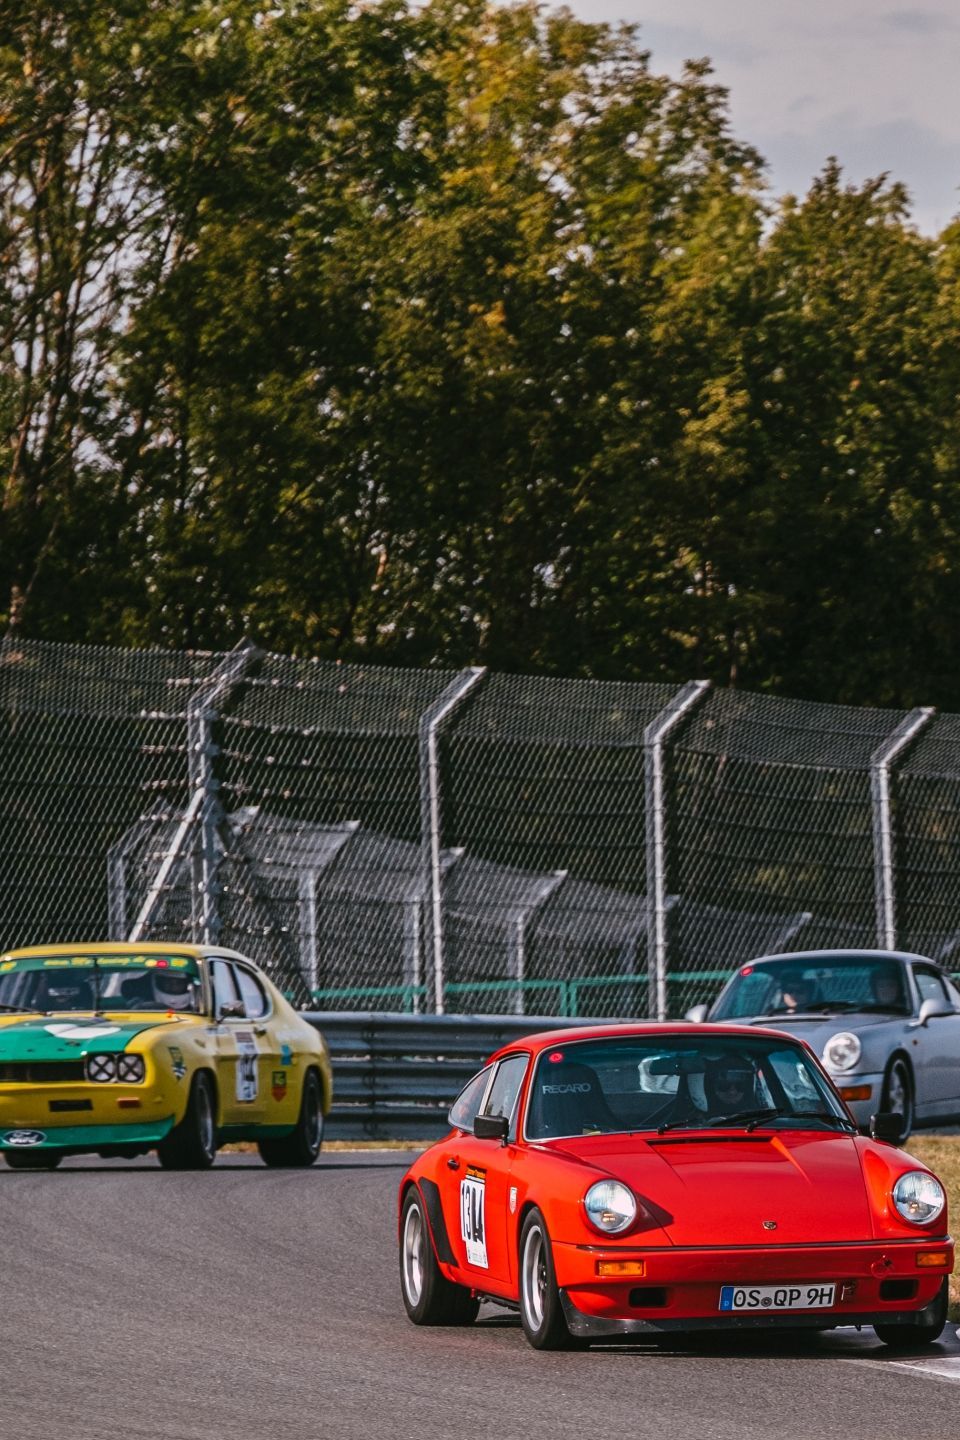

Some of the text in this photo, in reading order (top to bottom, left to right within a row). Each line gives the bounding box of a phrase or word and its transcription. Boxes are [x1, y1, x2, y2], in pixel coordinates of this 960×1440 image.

[542, 1083, 592, 1095] RECARO
[733, 1286, 834, 1308] OS QP 9H
